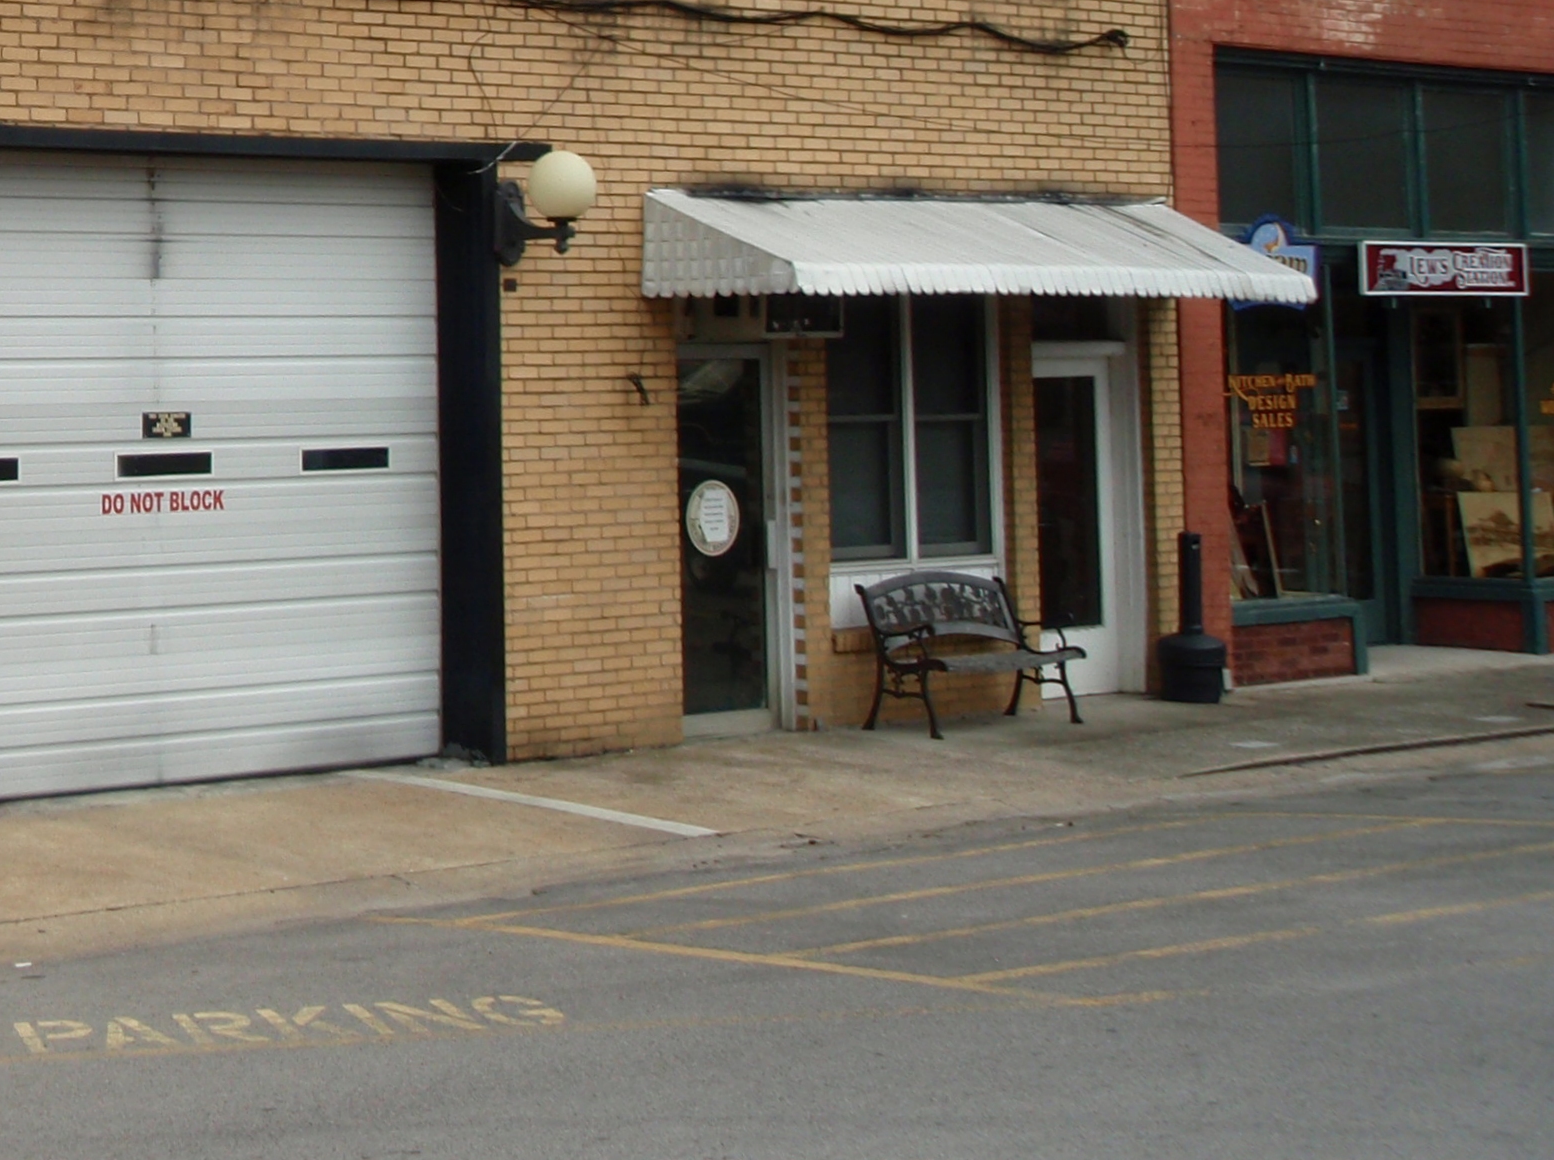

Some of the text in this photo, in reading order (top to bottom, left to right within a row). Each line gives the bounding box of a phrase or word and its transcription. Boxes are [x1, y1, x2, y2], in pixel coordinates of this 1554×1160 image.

[1247, 395, 1296, 411] DESIGN
[1252, 413, 1294, 428] SALES
[101, 489, 224, 515] DO NOT BLOCK
[13, 994, 565, 1053] PARKING
